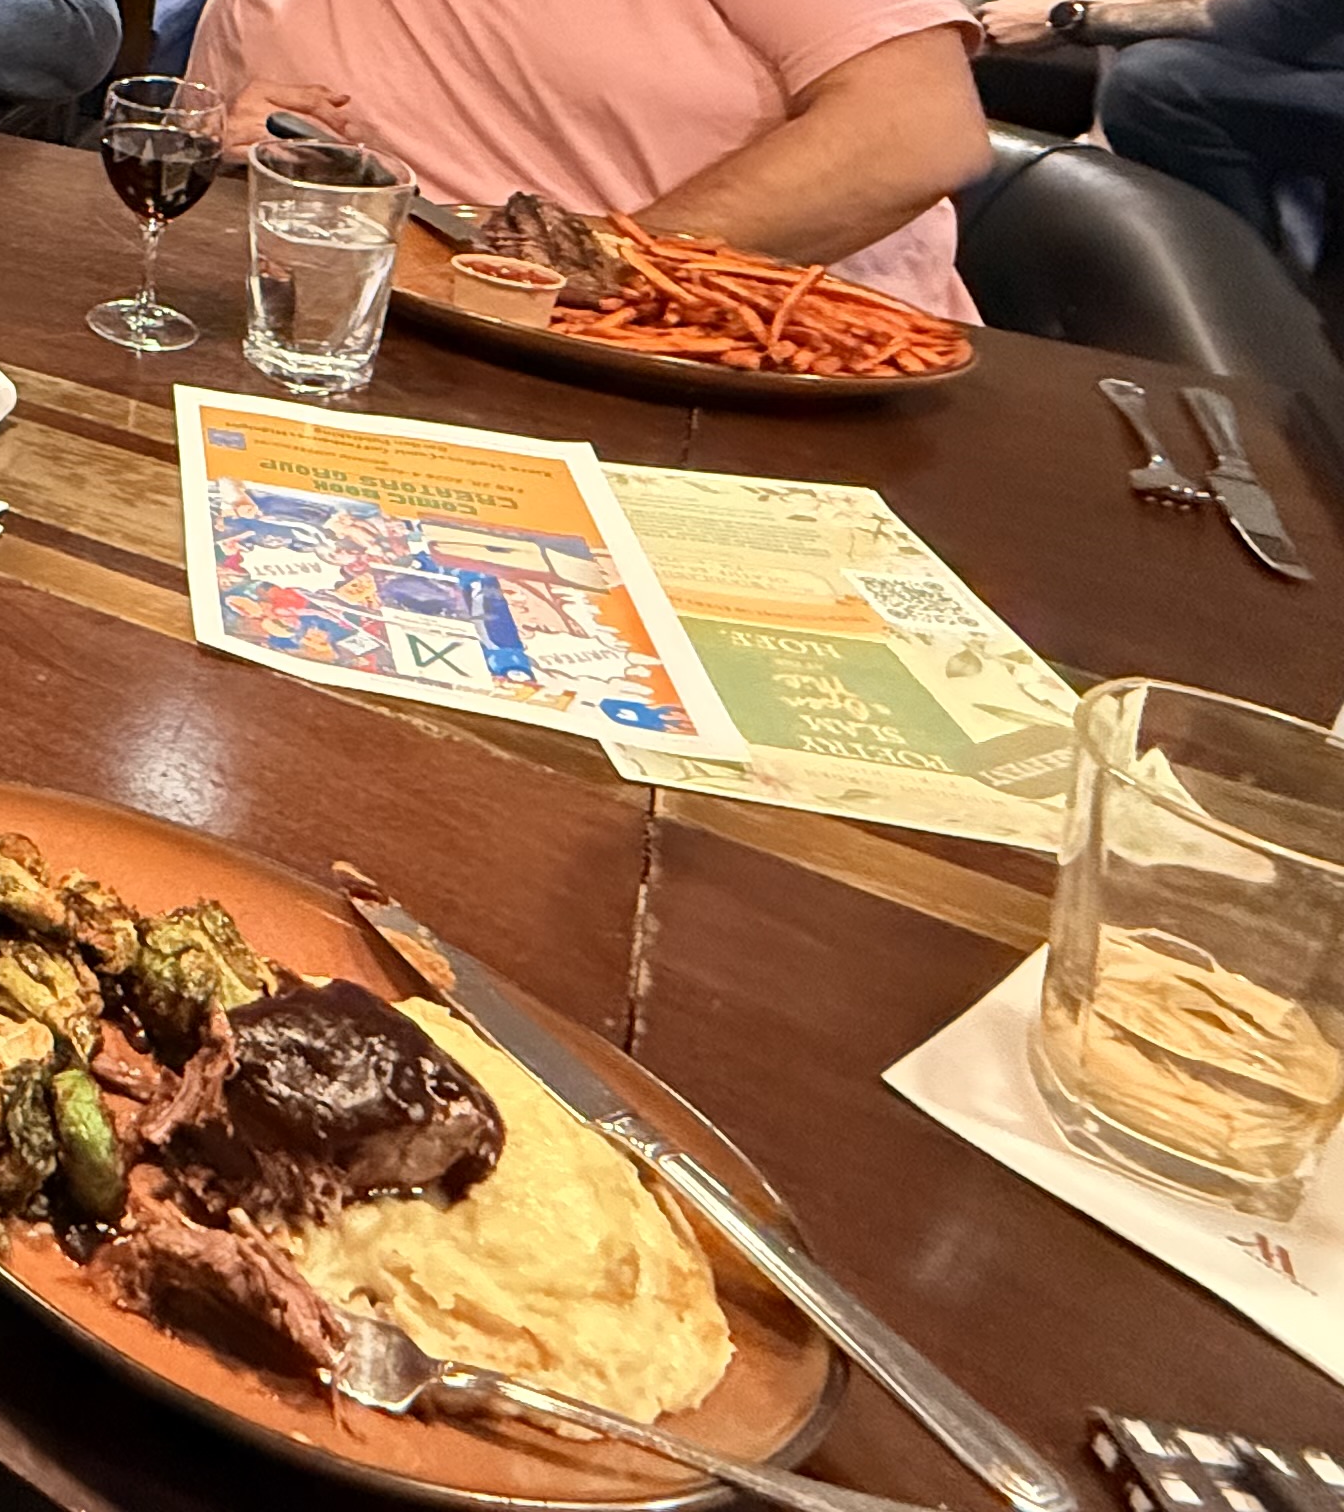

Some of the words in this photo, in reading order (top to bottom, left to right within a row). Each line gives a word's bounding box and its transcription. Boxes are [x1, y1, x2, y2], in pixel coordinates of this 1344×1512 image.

[259, 459, 348, 482] GROUP
[313, 479, 380, 500] BOOK
[358, 475, 519, 510] CREATORS
[387, 491, 478, 516] COMIC
[253, 562, 322, 576] ARTIST
[538, 650, 620, 666] WRITERS
[799, 714, 907, 744] SLAM
[798, 734, 956, 773] POETRY
